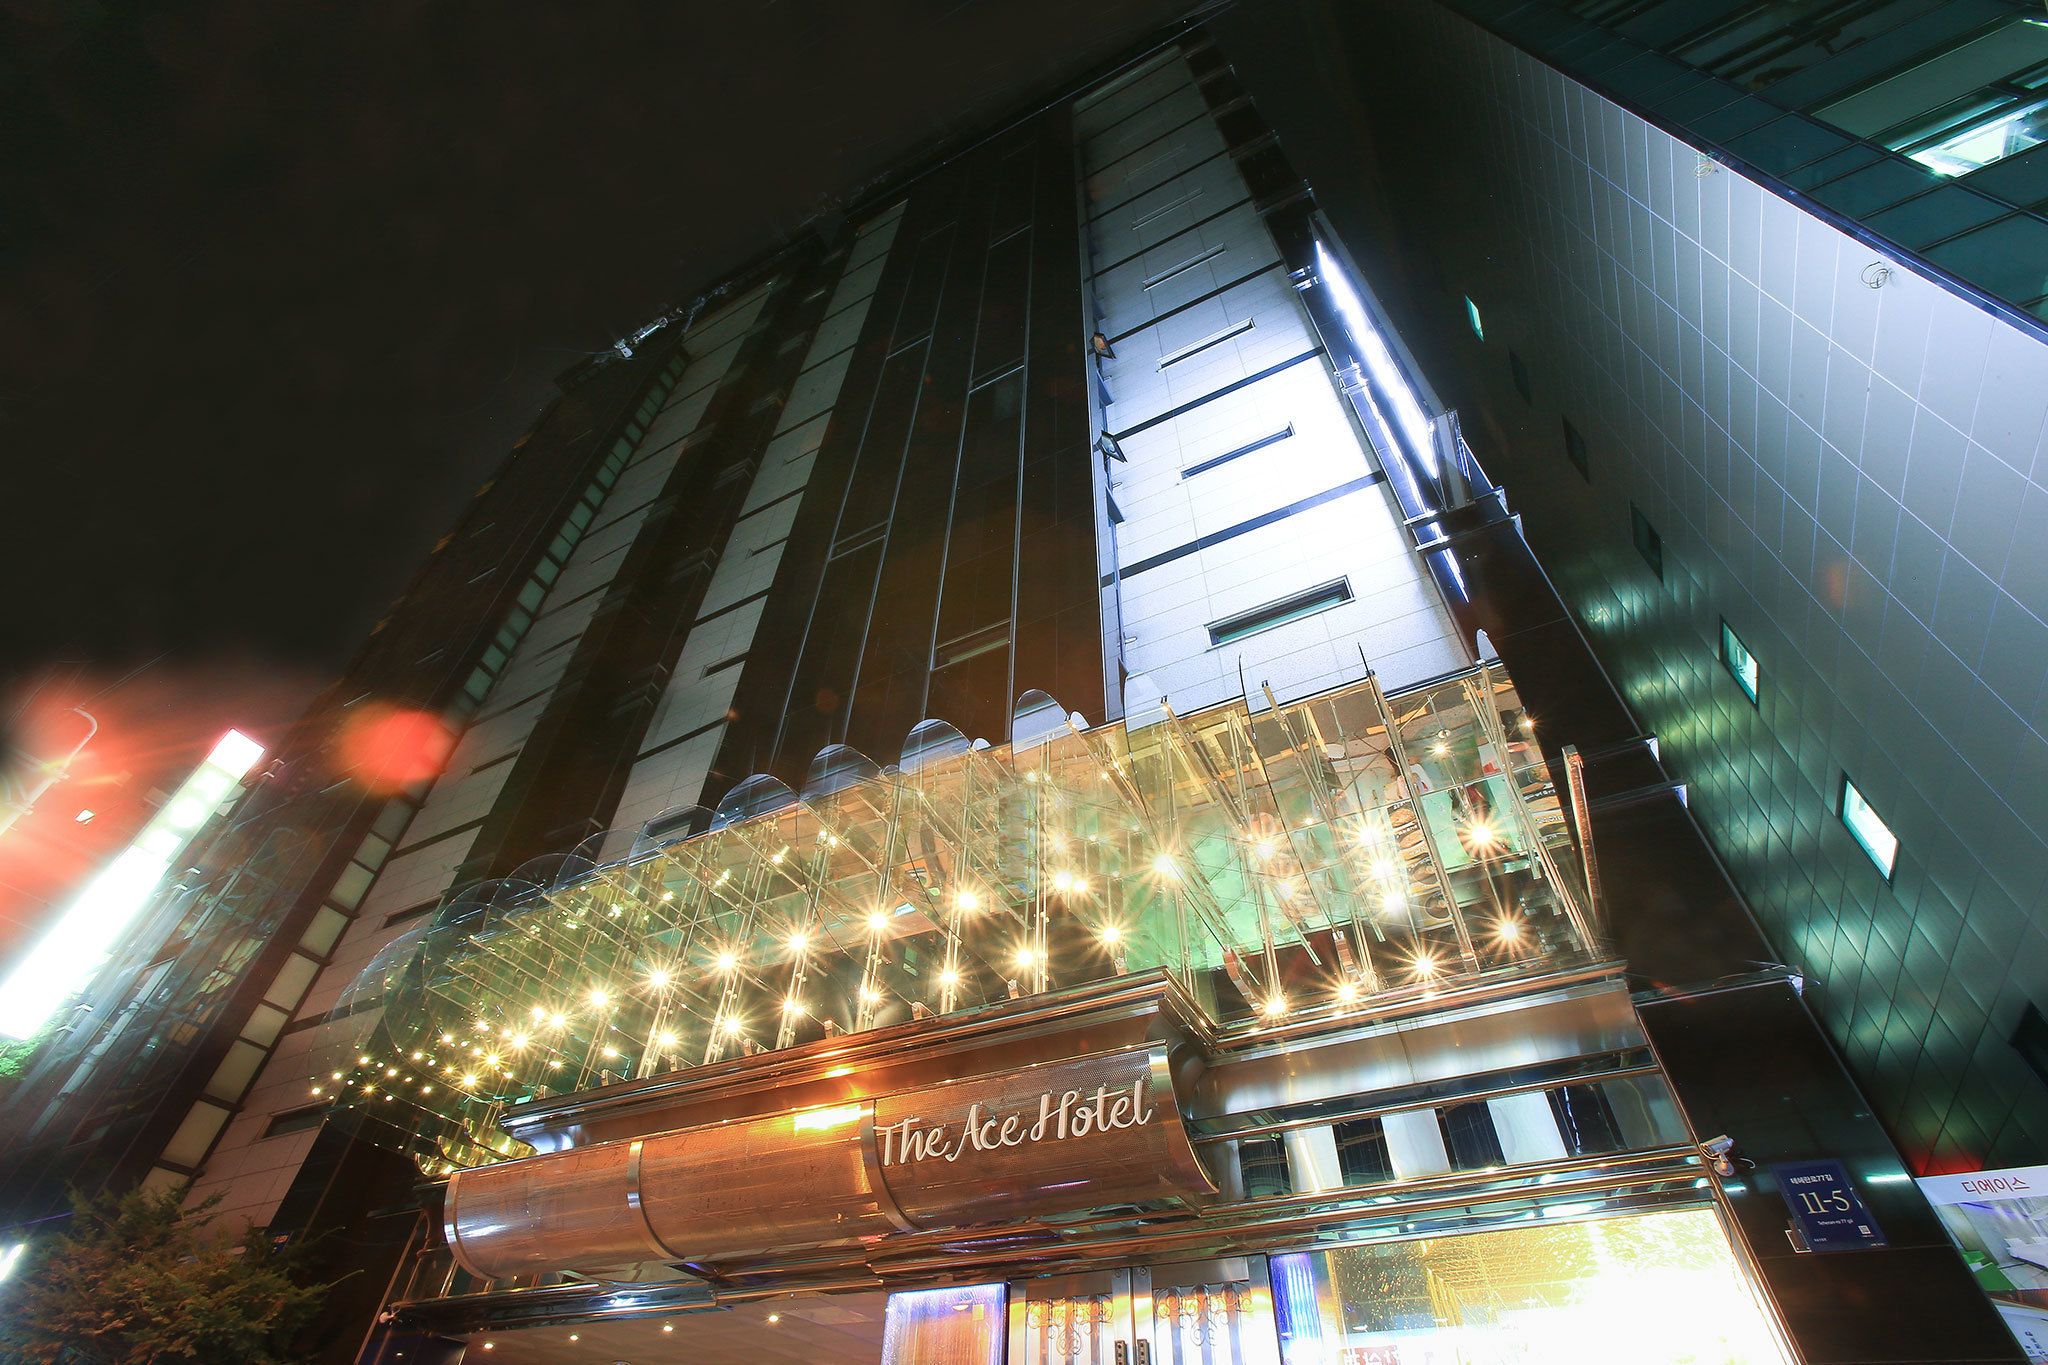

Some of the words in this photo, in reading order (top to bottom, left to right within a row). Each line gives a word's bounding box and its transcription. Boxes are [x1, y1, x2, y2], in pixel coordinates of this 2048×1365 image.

[873, 1117, 950, 1166] The
[945, 1103, 1027, 1162] Ace
[1030, 1078, 1152, 1141] Hotel
[1961, 1176, 2030, 1195] 디에이스
[1798, 1189, 1850, 1214] 11-5
